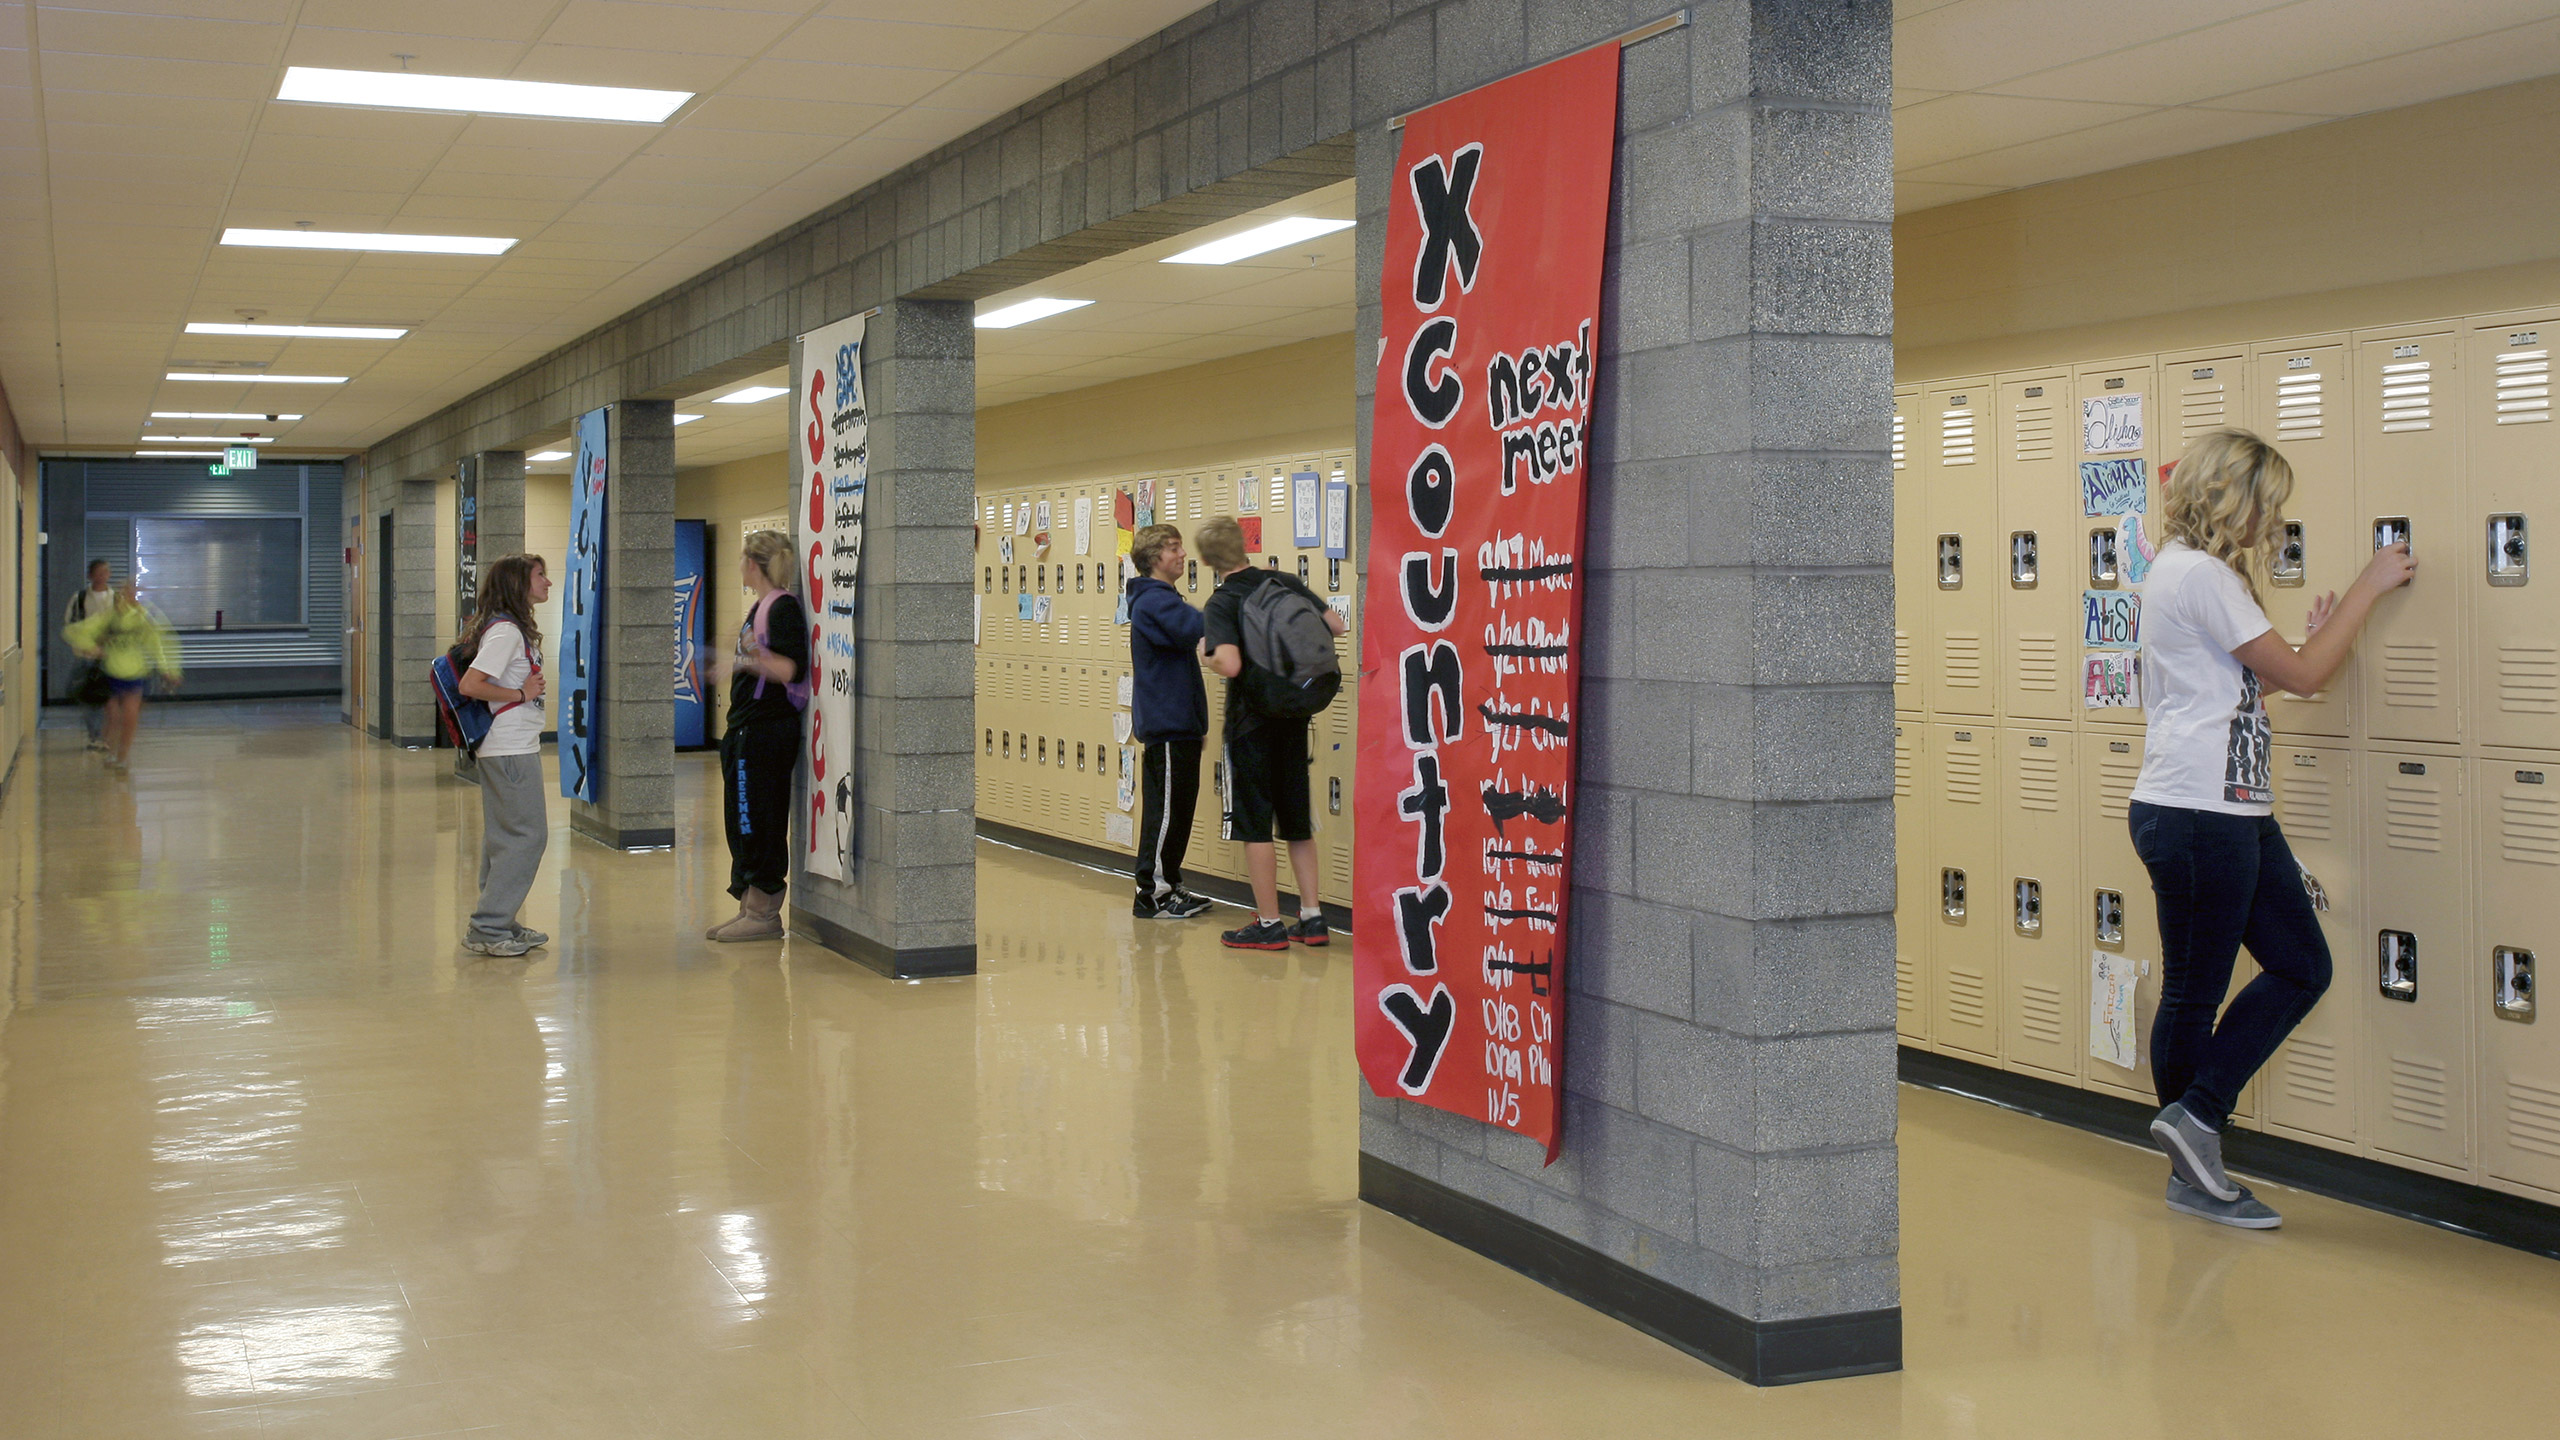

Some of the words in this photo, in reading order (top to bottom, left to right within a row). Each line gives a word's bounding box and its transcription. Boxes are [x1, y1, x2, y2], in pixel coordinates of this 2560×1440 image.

[1487, 317, 1592, 431] next
[229, 450, 254, 468] EXIT
[737, 758, 753, 836] FREEMAN
[1488, 1082, 1520, 1127] 11/5
